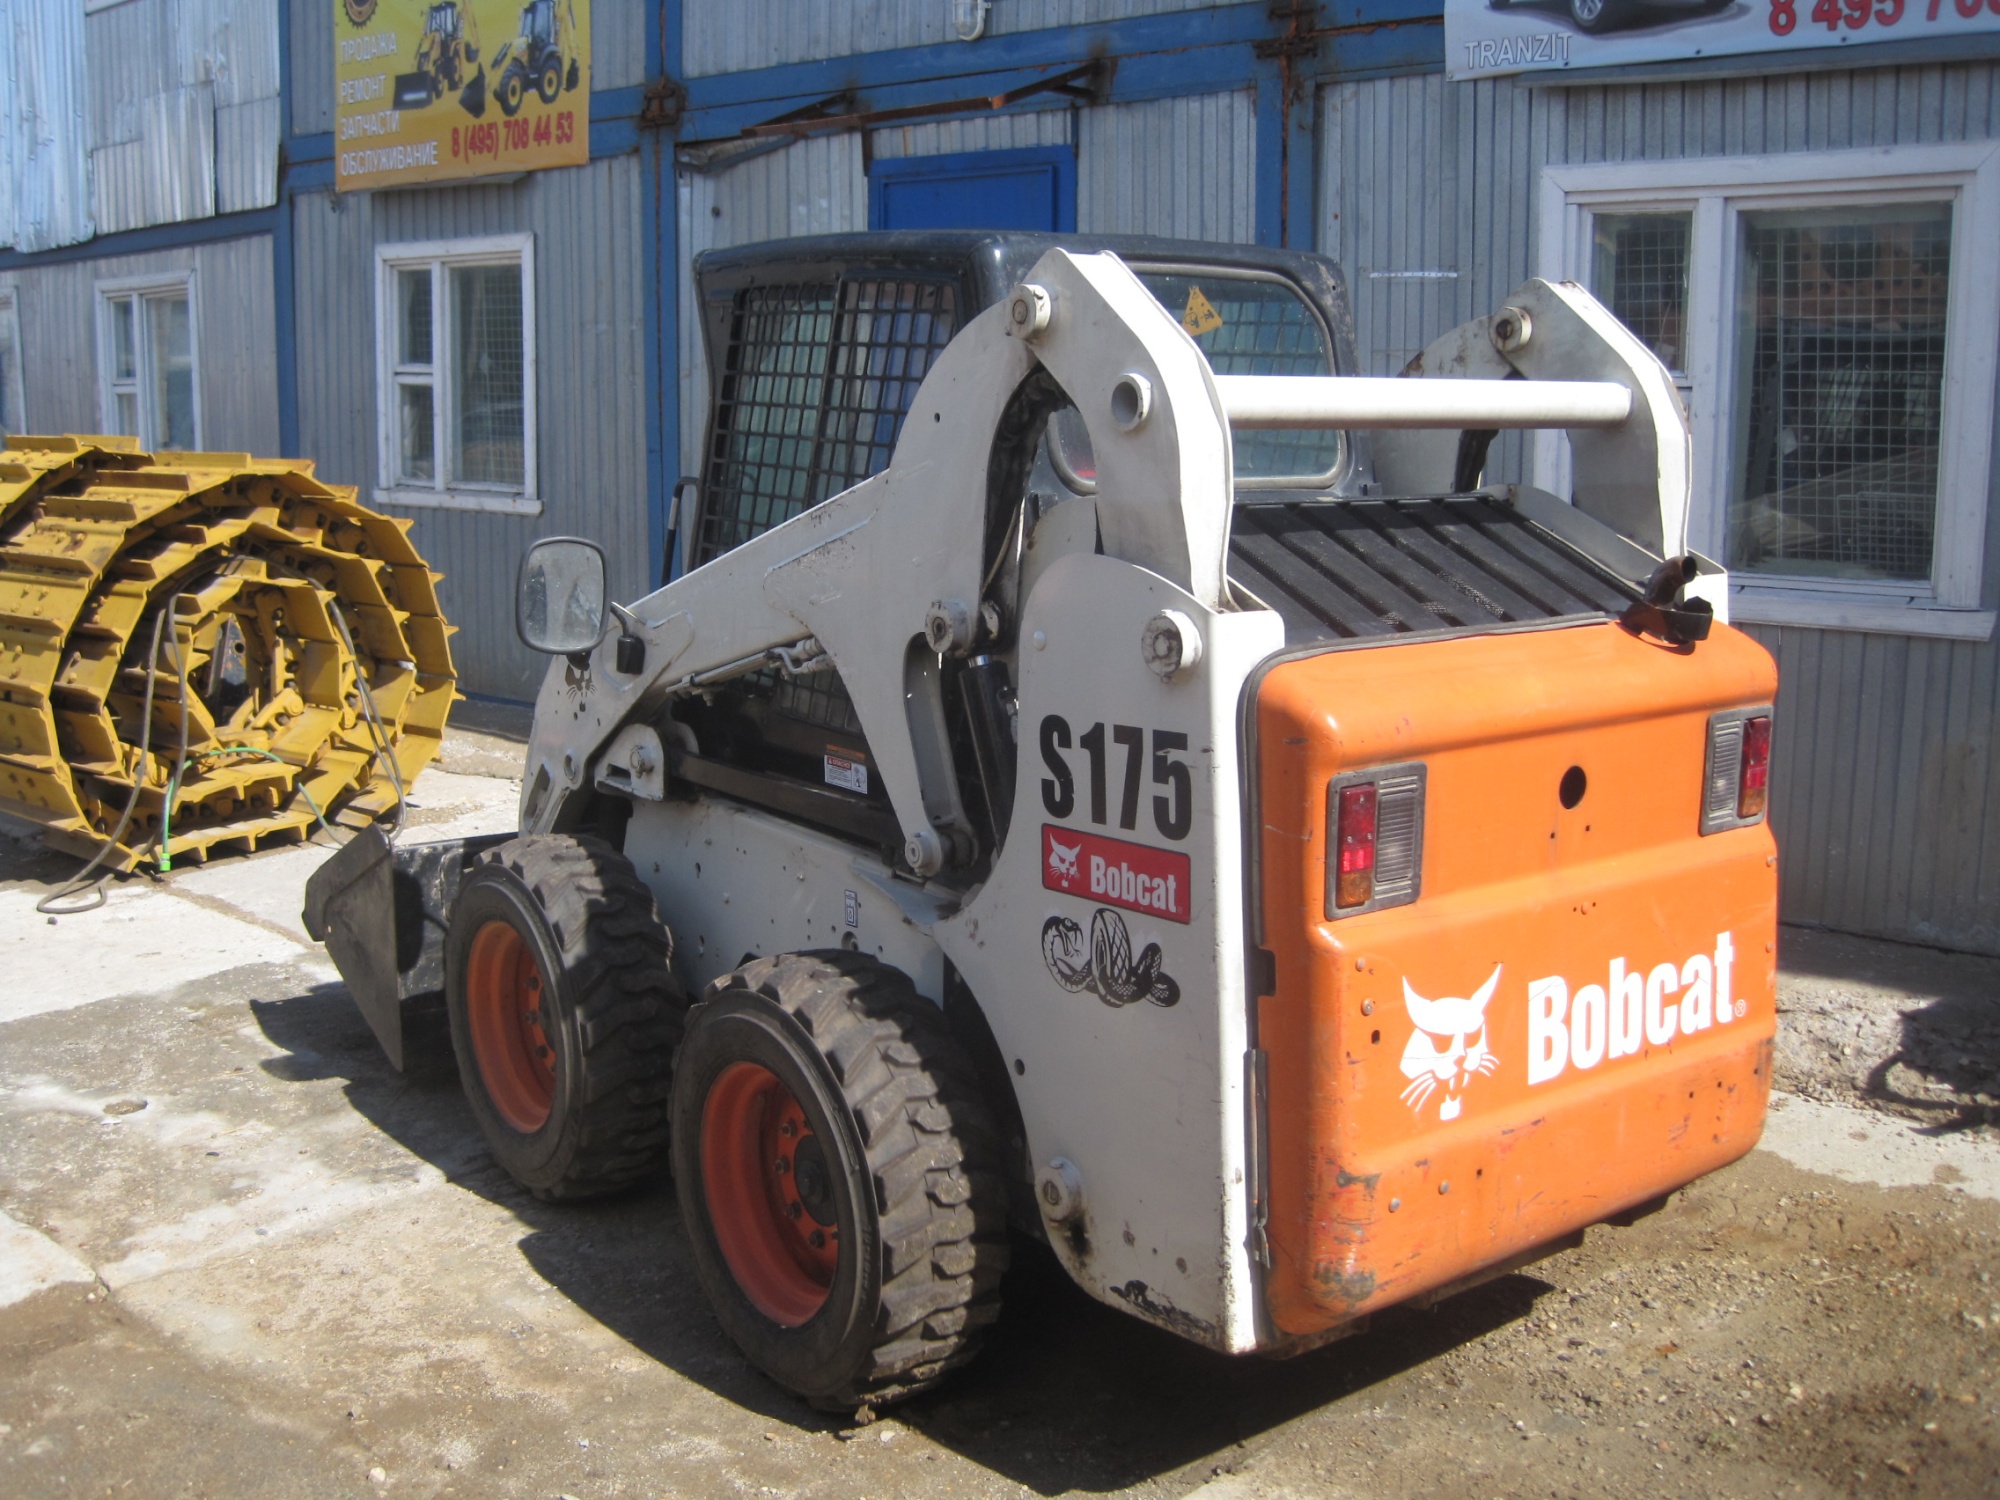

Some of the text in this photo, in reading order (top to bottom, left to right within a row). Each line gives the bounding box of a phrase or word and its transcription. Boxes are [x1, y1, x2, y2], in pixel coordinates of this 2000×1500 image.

[1769, 0, 1797, 37] 8
[340, 31, 397, 64] ПРОДАЖА
[1464, 33, 1572, 69] TRANZIT
[340, 74, 387, 104] РЕМОНТ
[340, 110, 400, 141] ЗАПЧАСТИ
[451, 111, 574, 163] 8 (495) 708 44 53
[341, 141, 439, 176] ОБСЛУЖИВАНИЕ
[1039, 714, 1192, 841] S175
[1090, 855, 1177, 914] Bobcat
